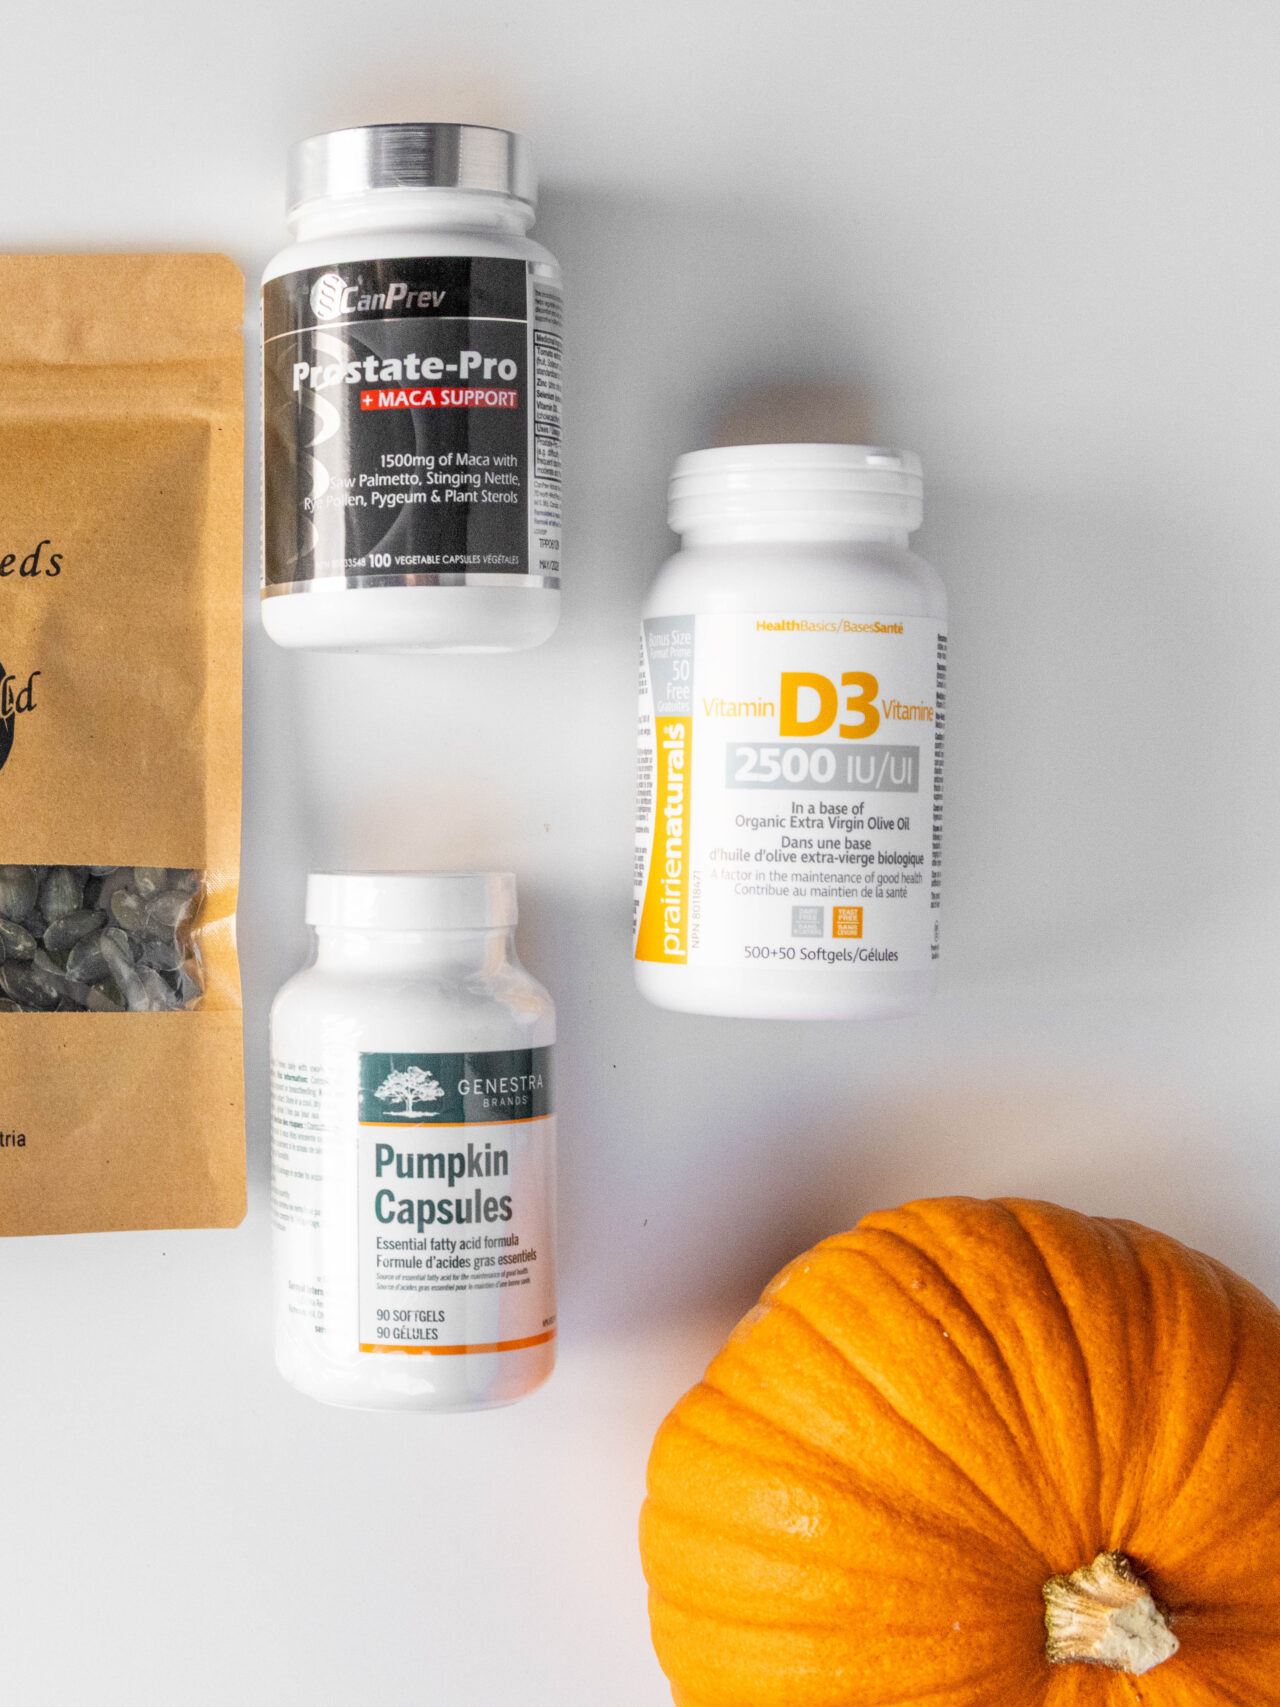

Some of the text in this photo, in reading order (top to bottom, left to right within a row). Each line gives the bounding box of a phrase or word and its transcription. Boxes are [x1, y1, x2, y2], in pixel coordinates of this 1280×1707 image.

[340, 283, 446, 313] CanPrev
[293, 350, 517, 392] Prostate-Pro
[379, 390, 517, 407] MACA SUPPORT
[381, 453, 517, 469] 1500mg of Maca with
[331, 472, 520, 489] Saw Palmetto, Stinging Nettle,
[372, 492, 426, 508] Pygeum
[431, 490, 441, 502] &
[445, 490, 478, 502] Plant
[482, 491, 518, 503] Sterols
[369, 554, 480, 567] 100 VEGETABLE CAPSULES
[672, 630, 691, 645] Size
[673, 660, 689, 680] 50
[666, 682, 689, 700] Free
[703, 672, 934, 739] Vitamin D3 Vitamine
[734, 747, 836, 784] 2500
[792, 802, 864, 815] In a base of
[735, 815, 910, 832] Organic Extra Virgin Olive Oil
[660, 722, 686, 956] prairienaturals
[782, 836, 871, 849] Dans une base
[709, 848, 924, 867] d'huile d'olive extra-vierge biologique
[721, 868, 922, 886] factor in the maintenance of good health
[735, 883, 907, 899] Contribue au maintien de la santé
[744, 946, 898, 964] 500+50 Softgels/Gélules
[458, 1074, 543, 1095] GENESTRA
[483, 1096, 528, 1108] BRANDS
[375, 1143, 508, 1187] Pumpkin
[375, 1189, 512, 1233] Capsules
[376, 1233, 519, 1253] Essential fatty acid formula
[376, 1248, 537, 1270] Formule d'acides gras essentiels
[377, 1310, 445, 1322] 90 SOFTGELS
[377, 1325, 438, 1340] 90 GÉLULES
